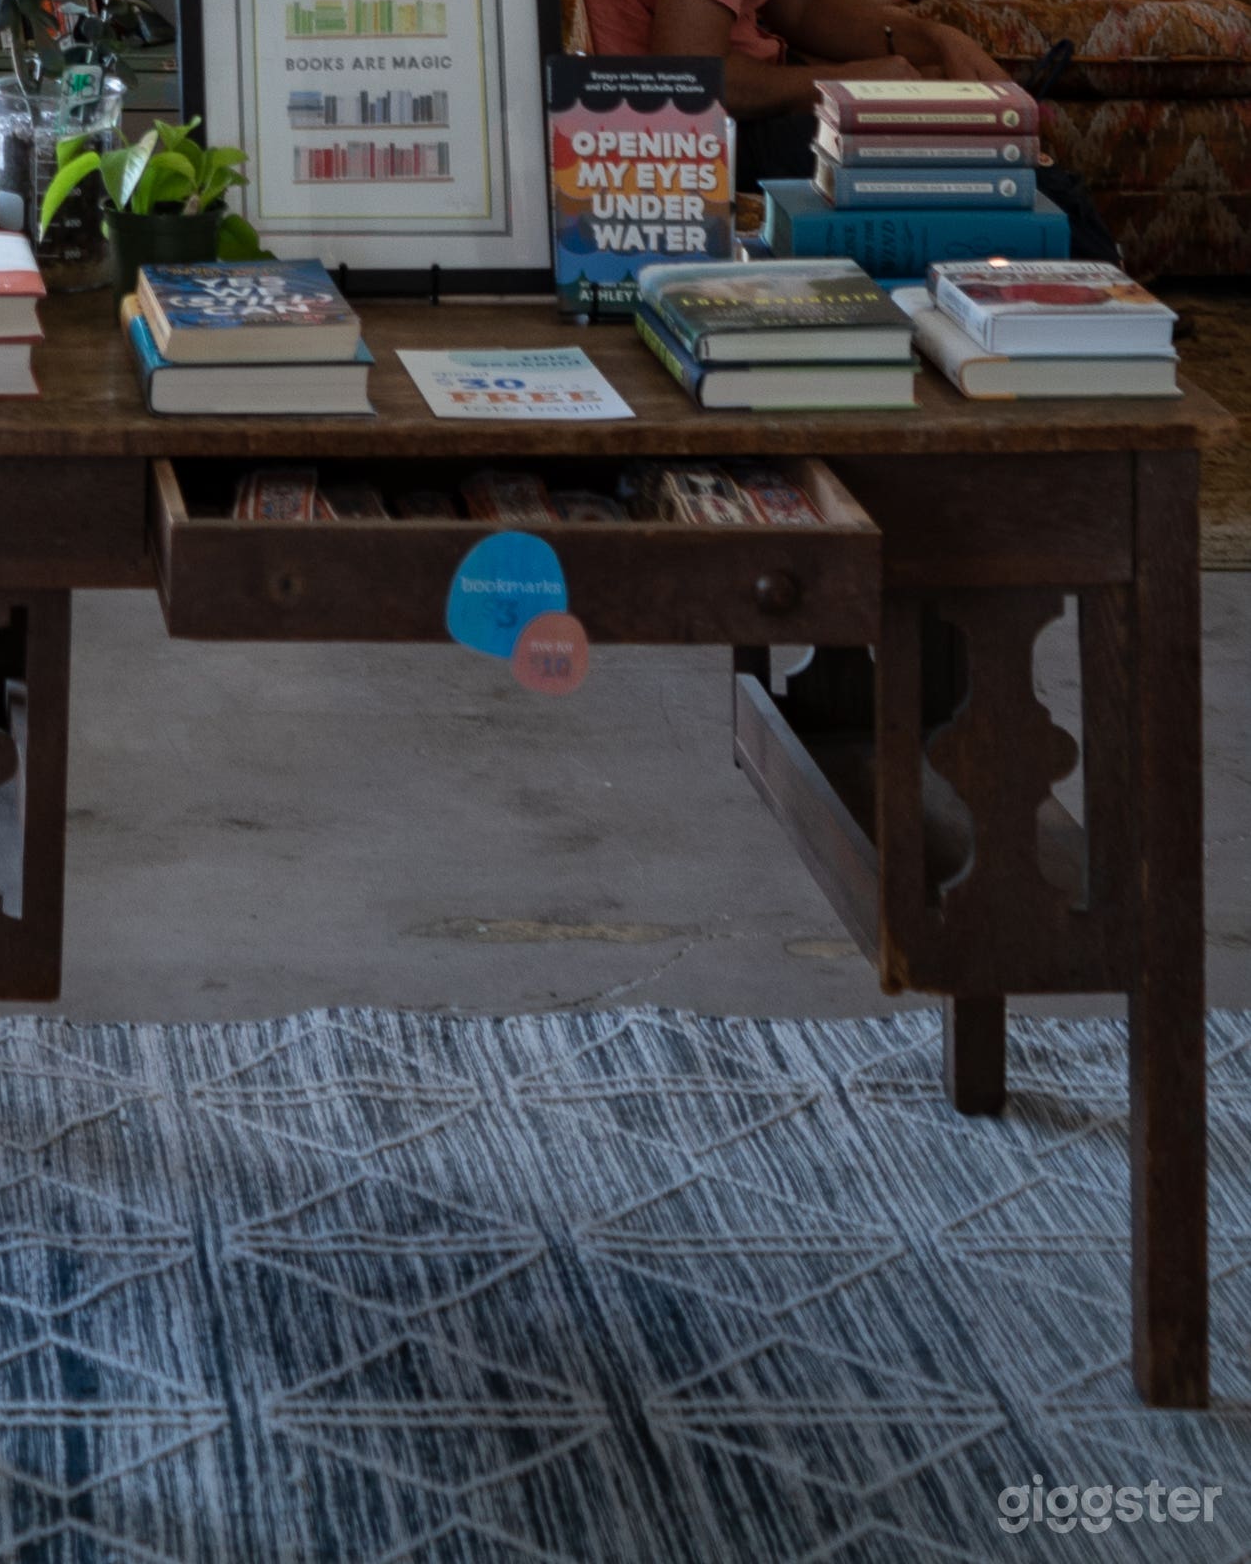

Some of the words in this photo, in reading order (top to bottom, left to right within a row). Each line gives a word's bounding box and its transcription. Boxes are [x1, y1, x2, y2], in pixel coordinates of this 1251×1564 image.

[285, 56, 344, 71] BOOKS
[352, 56, 386, 71] ARE
[393, 55, 452, 70] MAGIC
[590, 71, 618, 82] Essays
[572, 131, 721, 159] OPENING
[577, 162, 629, 187] MY
[636, 163, 718, 190] EYES
[592, 193, 705, 221] UNDER
[592, 223, 707, 252] WATER
[193, 276, 286, 287] YES
[202, 287, 287, 296] WE
[202, 305, 311, 315] CAN
[470, 359, 581, 368] weekend
[436, 378, 526, 389] $30
[448, 391, 603, 404] FREE
[461, 576, 562, 595] bookmarks
